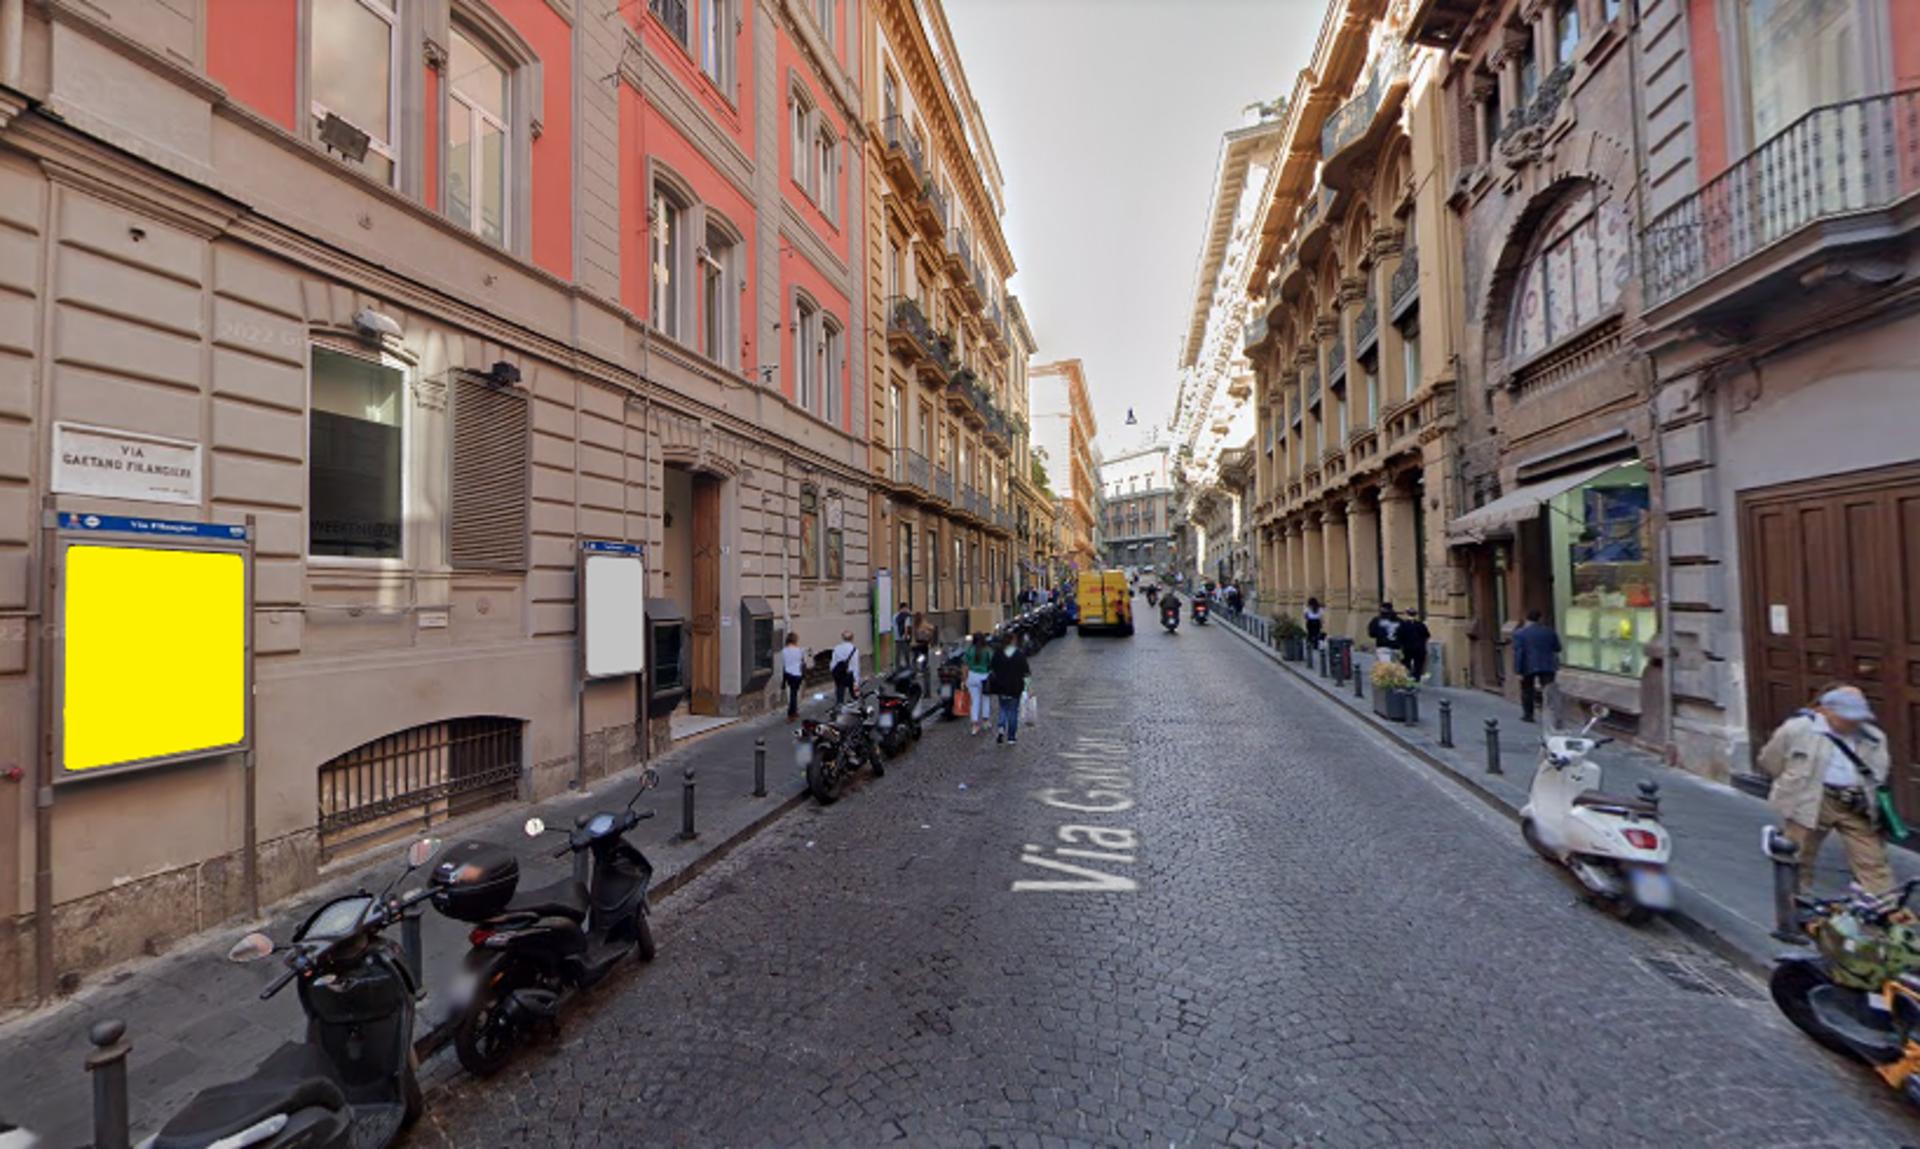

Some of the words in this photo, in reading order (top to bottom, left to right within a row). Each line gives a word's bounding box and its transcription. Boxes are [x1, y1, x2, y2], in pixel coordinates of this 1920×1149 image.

[120, 445, 145, 458] VIA
[62, 452, 123, 471] GAETANO
[126, 462, 192, 479] FILANGIERI
[130, 520, 149, 529] Via
